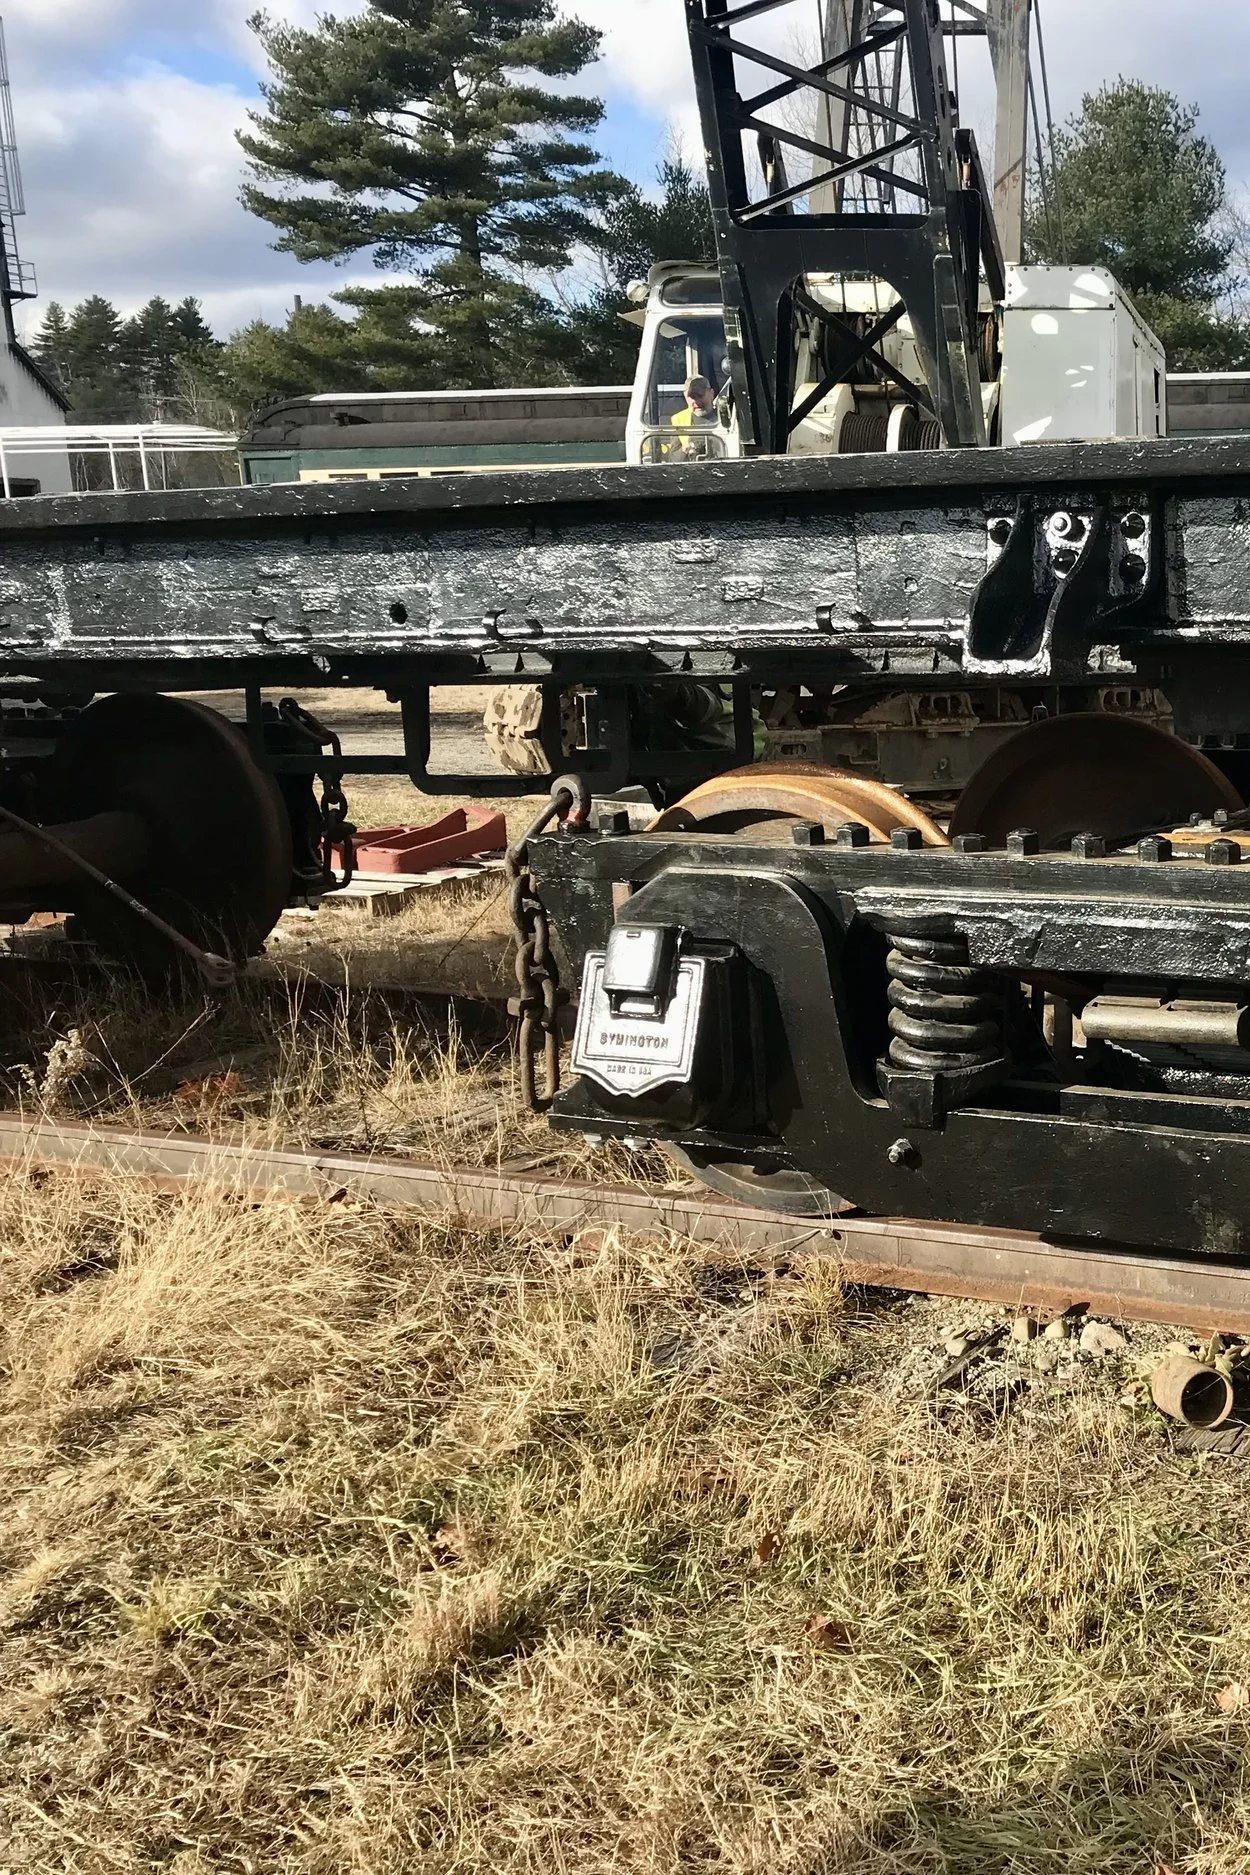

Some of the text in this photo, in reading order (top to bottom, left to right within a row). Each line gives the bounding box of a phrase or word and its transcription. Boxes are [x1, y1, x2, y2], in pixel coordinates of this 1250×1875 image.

[599, 1032, 670, 1049] SYMINGTON
[606, 1064, 626, 1074] MADE
[628, 1064, 637, 1075] IN
